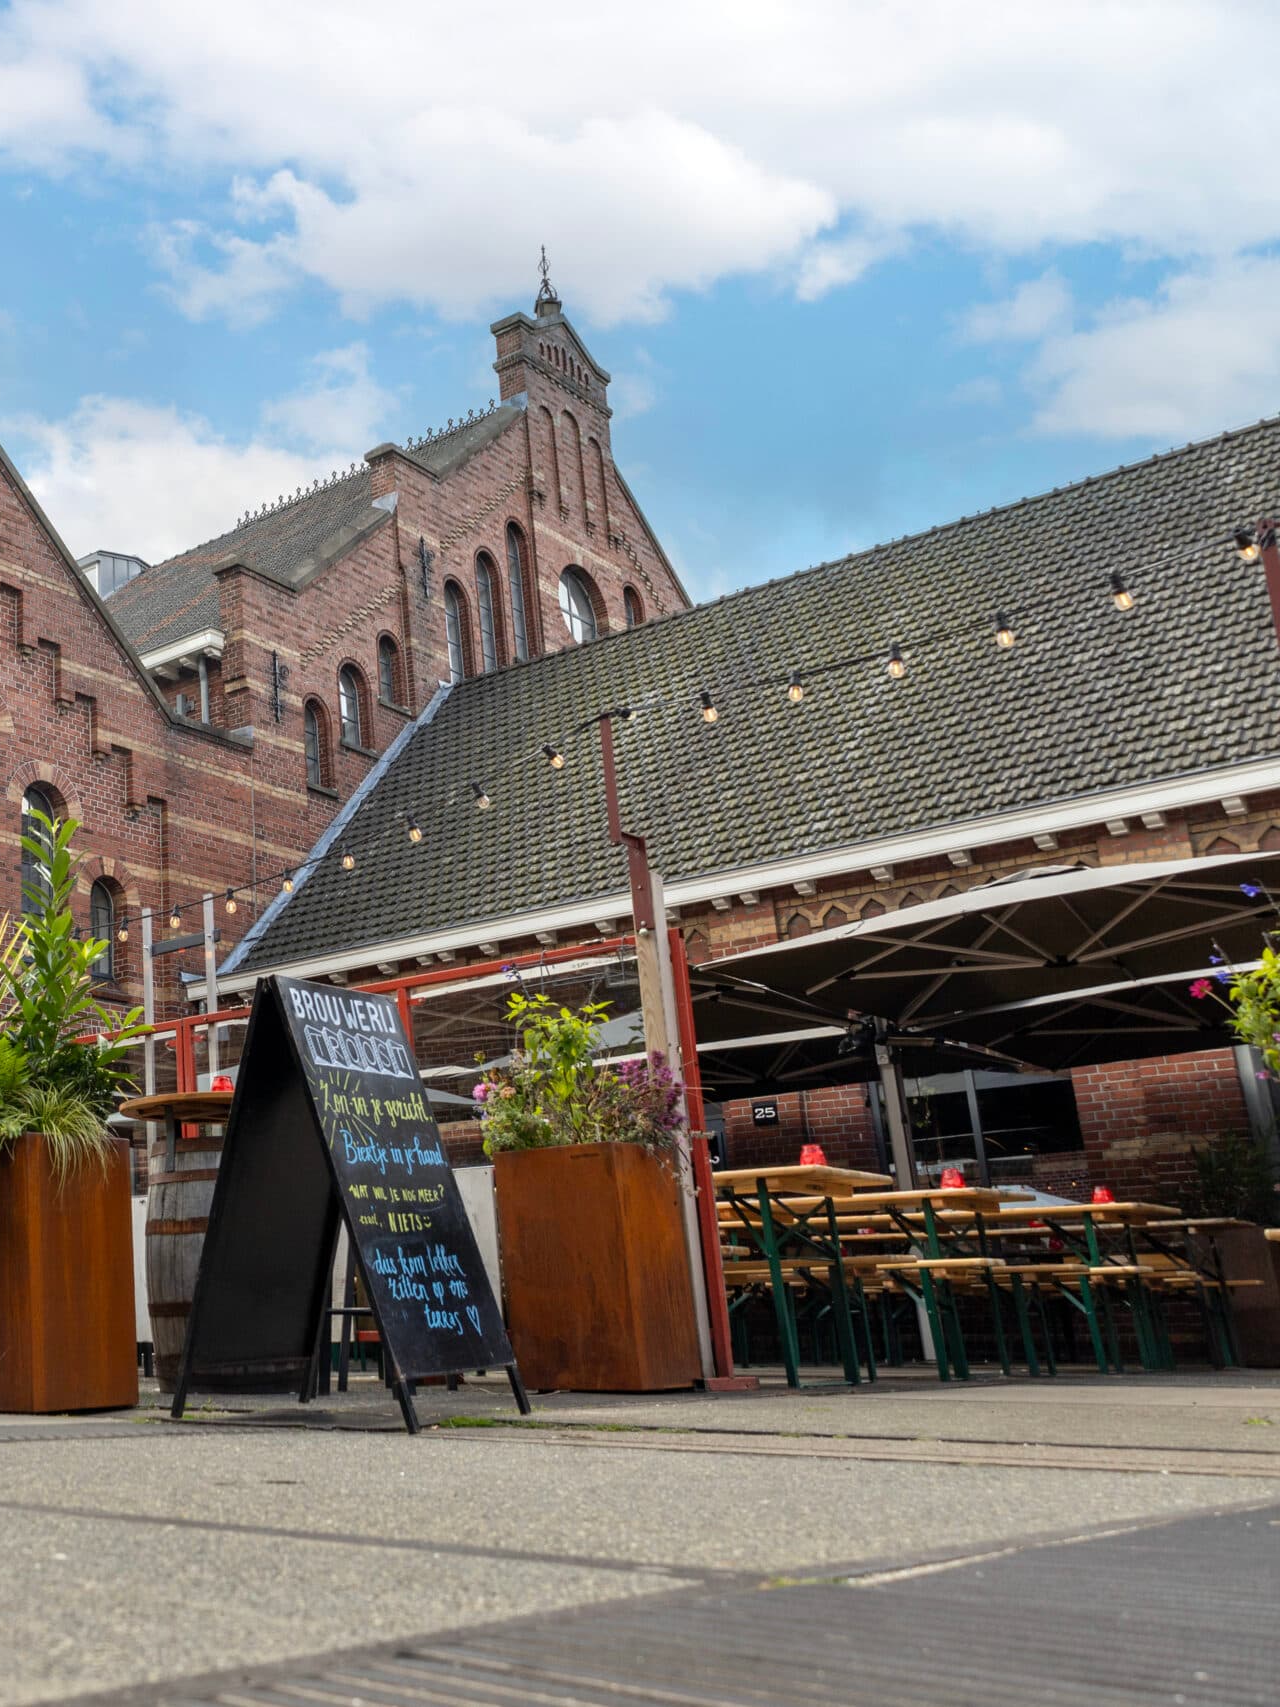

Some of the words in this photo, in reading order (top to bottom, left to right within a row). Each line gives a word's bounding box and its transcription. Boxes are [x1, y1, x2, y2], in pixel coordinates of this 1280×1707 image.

[290, 988, 398, 1034] BROUWERIJ
[304, 1025, 414, 1079] TROOST
[351, 1091, 370, 1117] in
[370, 1093, 384, 1126] je
[754, 1107, 776, 1119] 25
[390, 1142, 404, 1165] in
[406, 1144, 420, 1175] je
[348, 1184, 369, 1199] WAT
[372, 1185, 388, 1201] WIL
[390, 1187, 401, 1203] JE
[402, 1188, 417, 1202] NOG
[417, 1184, 444, 1203] MEER?
[388, 1211, 423, 1232] NIETS
[373, 1247, 397, 1275] dus
[398, 1246, 428, 1278] kom
[426, 1243, 467, 1277] lekker
[388, 1274, 429, 1301] zitten
[432, 1280, 445, 1305] op
[448, 1279, 468, 1299] ons
[424, 1303, 464, 1336] terras
